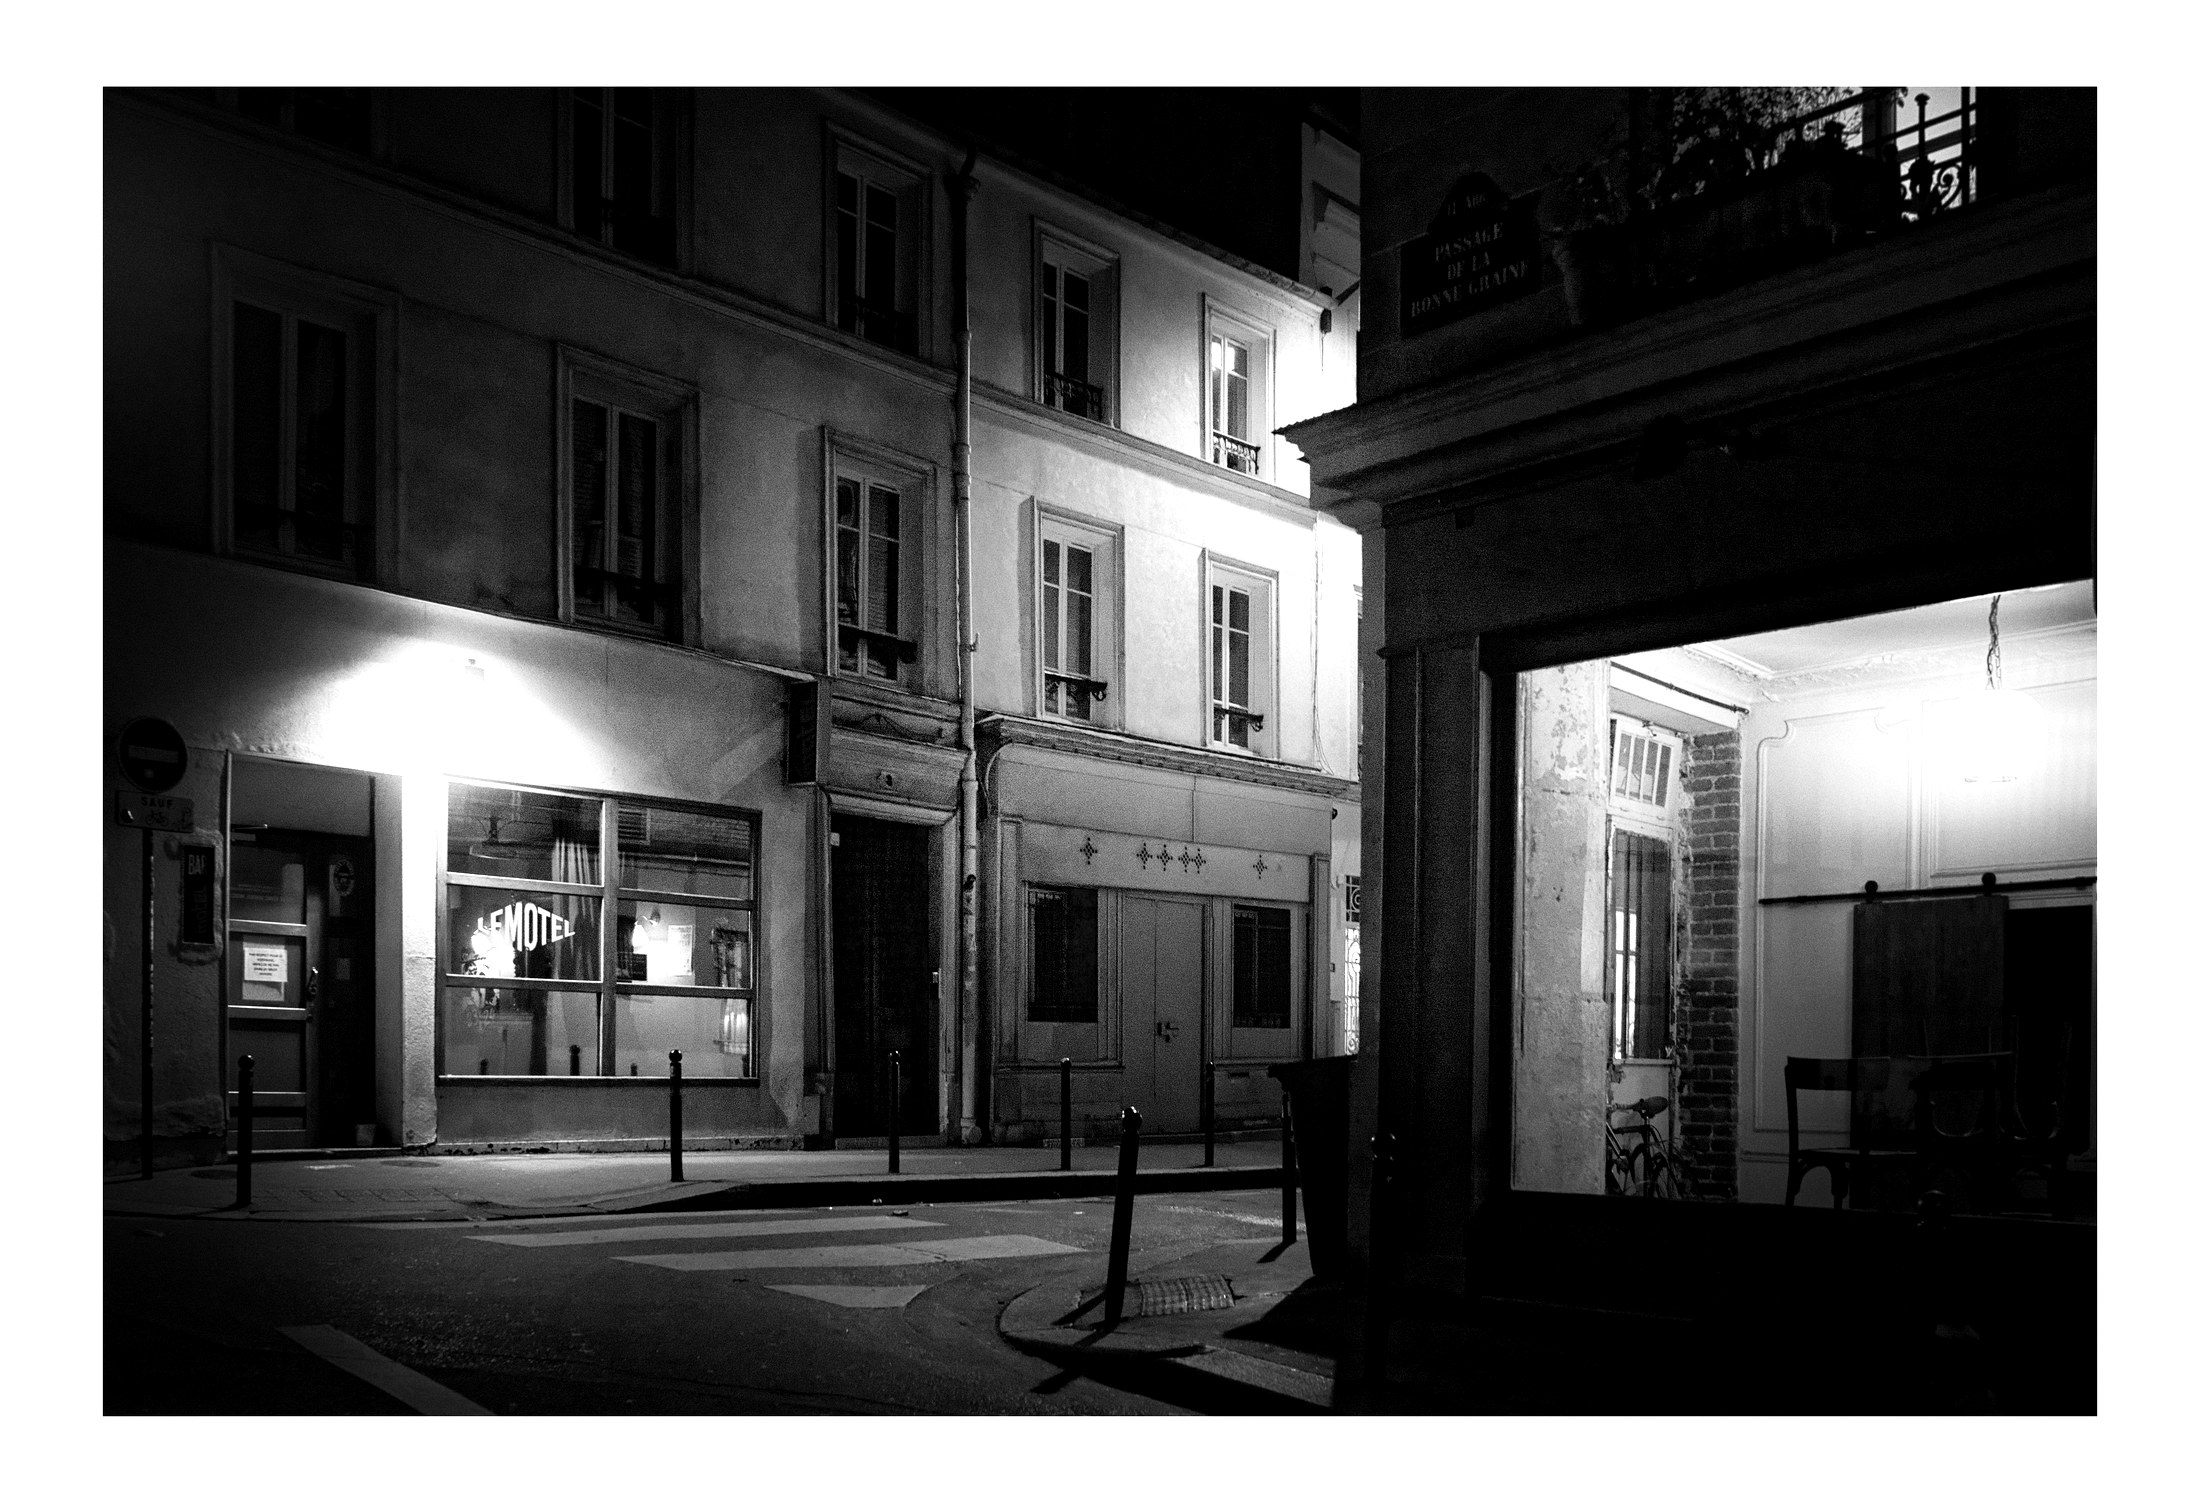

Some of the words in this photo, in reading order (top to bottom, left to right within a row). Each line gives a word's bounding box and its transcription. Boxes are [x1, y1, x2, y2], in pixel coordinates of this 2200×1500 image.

[1434, 221, 1504, 263] PASSAGE
[1446, 259, 1466, 281] DE
[1471, 250, 1491, 272] LA
[1410, 283, 1463, 319] BONNE
[1467, 258, 1530, 296] GRAINE
[141, 796, 173, 809] SAUF
[187, 853, 207, 876] BAR
